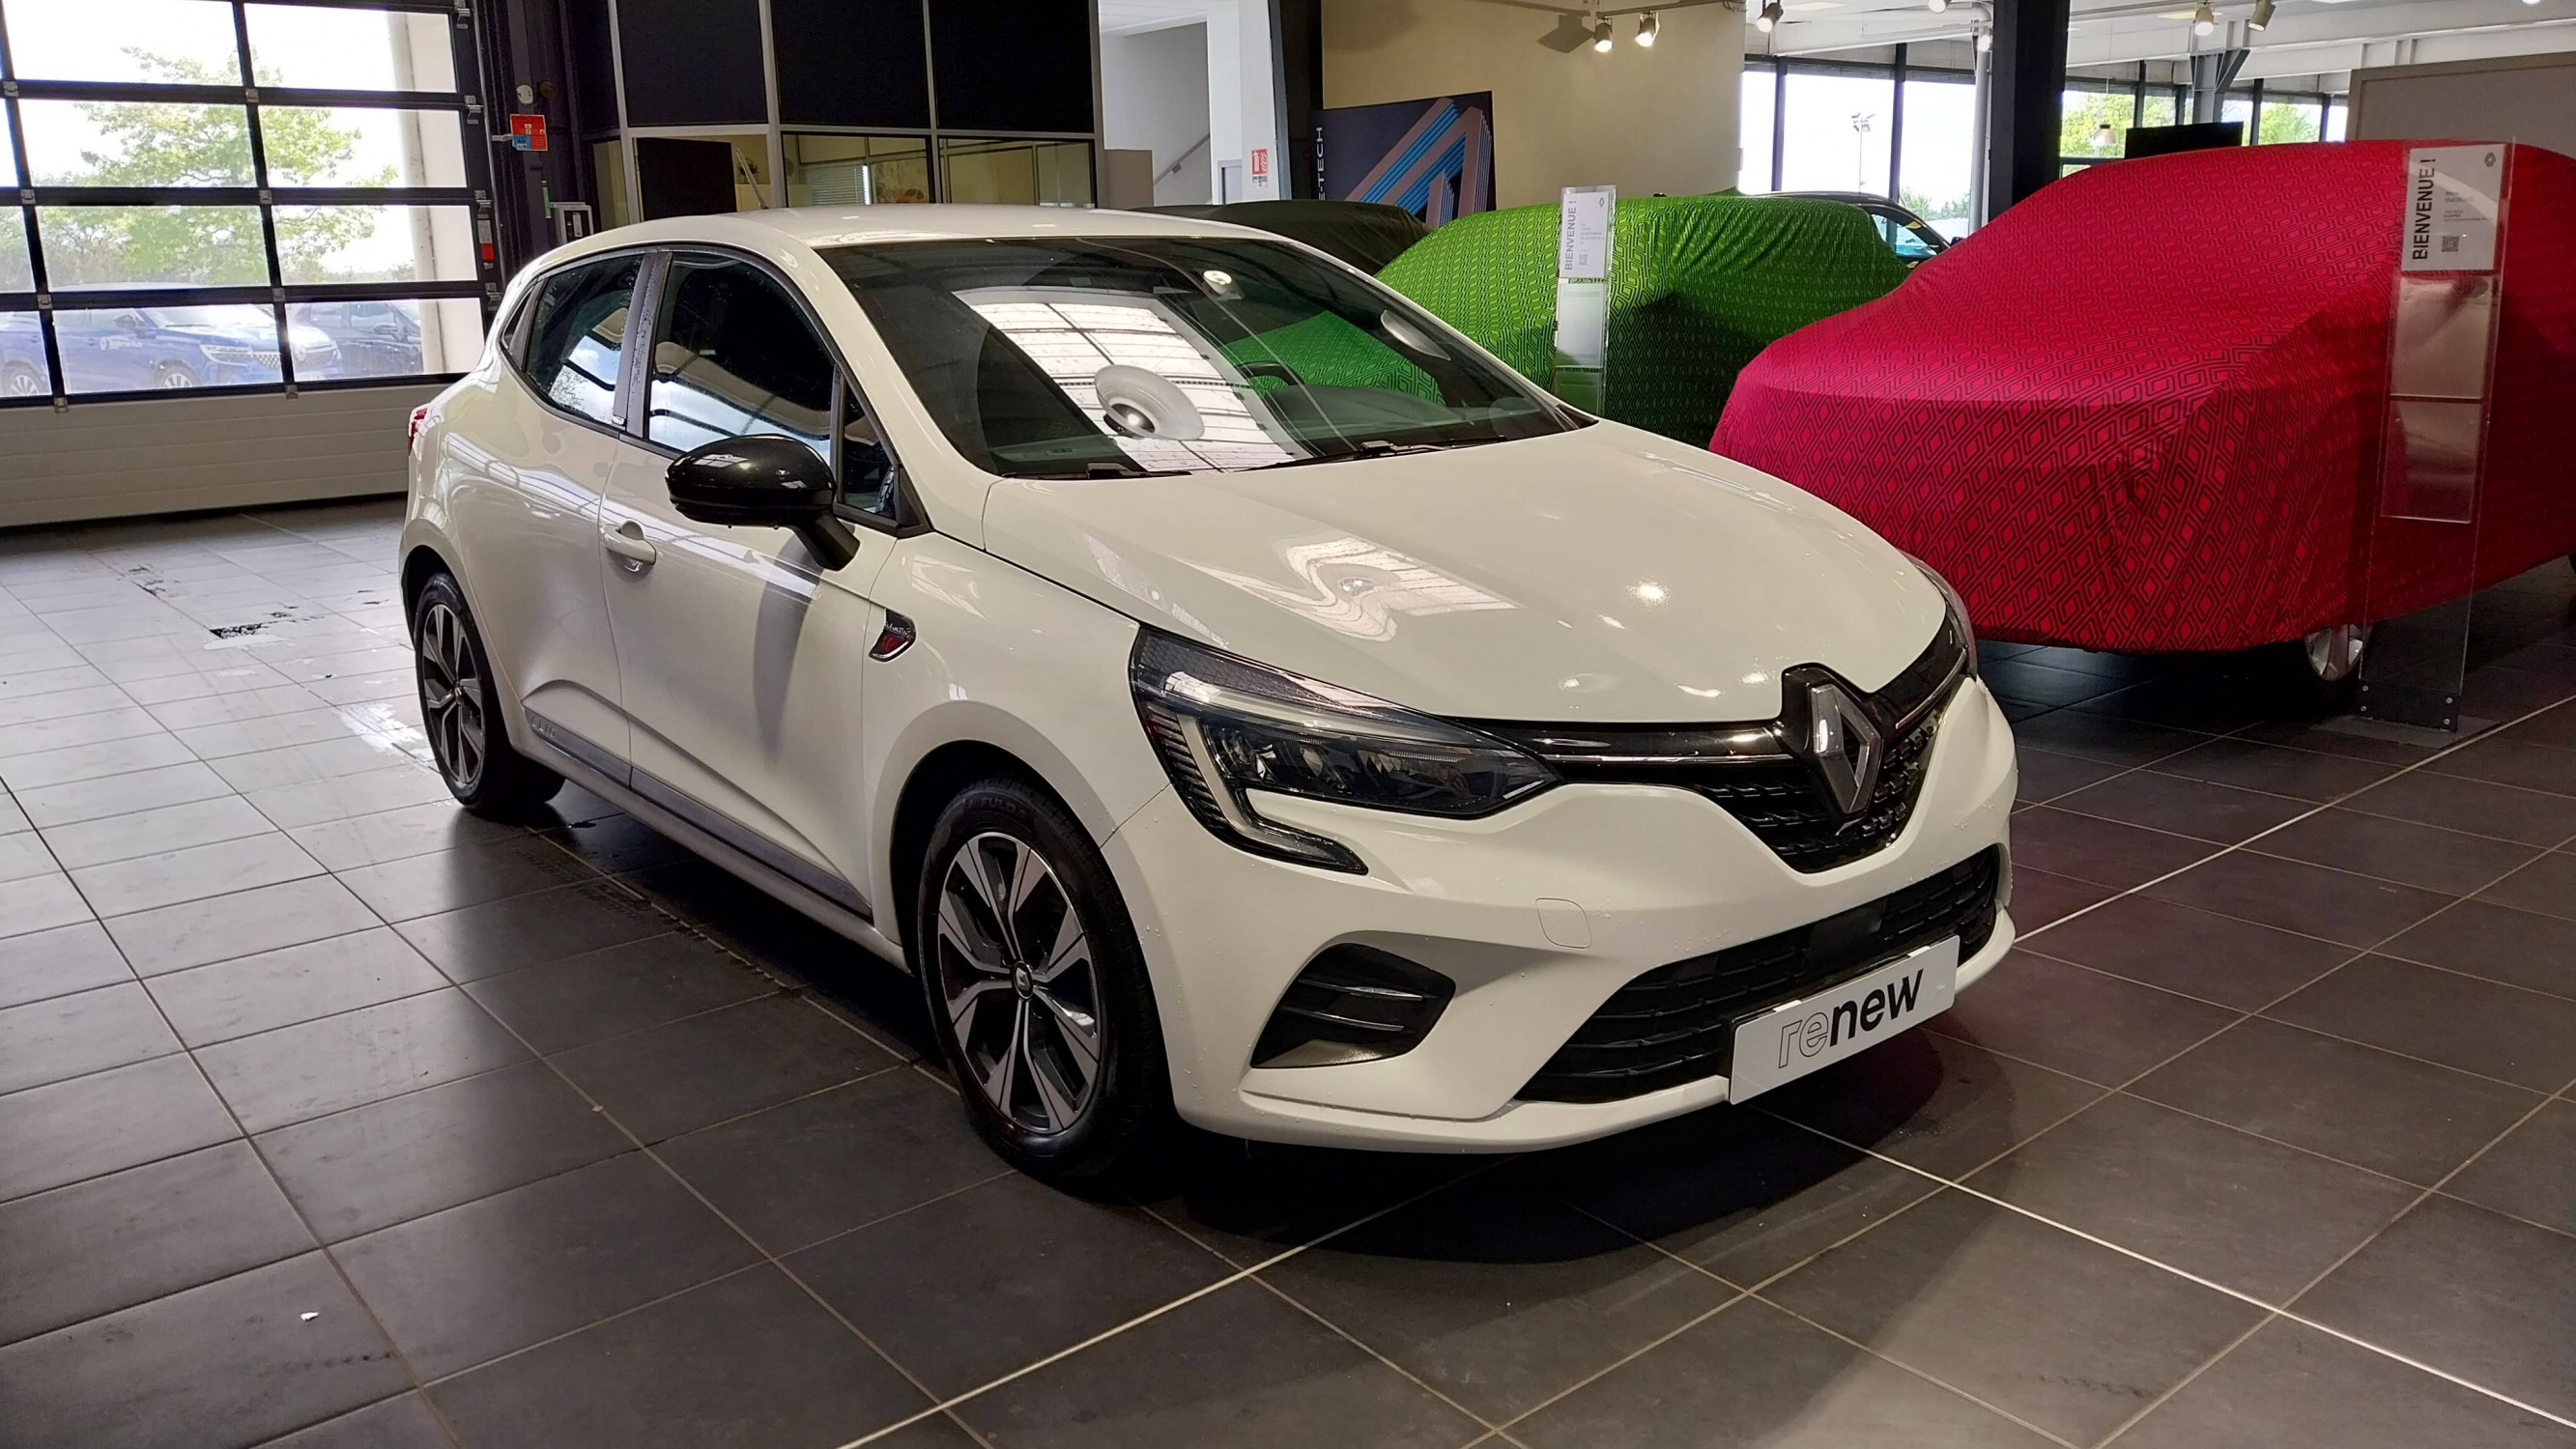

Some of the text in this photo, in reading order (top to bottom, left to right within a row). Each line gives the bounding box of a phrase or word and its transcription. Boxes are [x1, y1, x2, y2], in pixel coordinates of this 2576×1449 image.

[1564, 207, 1577, 270] BIENVENUE
[2412, 167, 2435, 260] BIENVENUE
[1778, 968, 1924, 1069] renew
